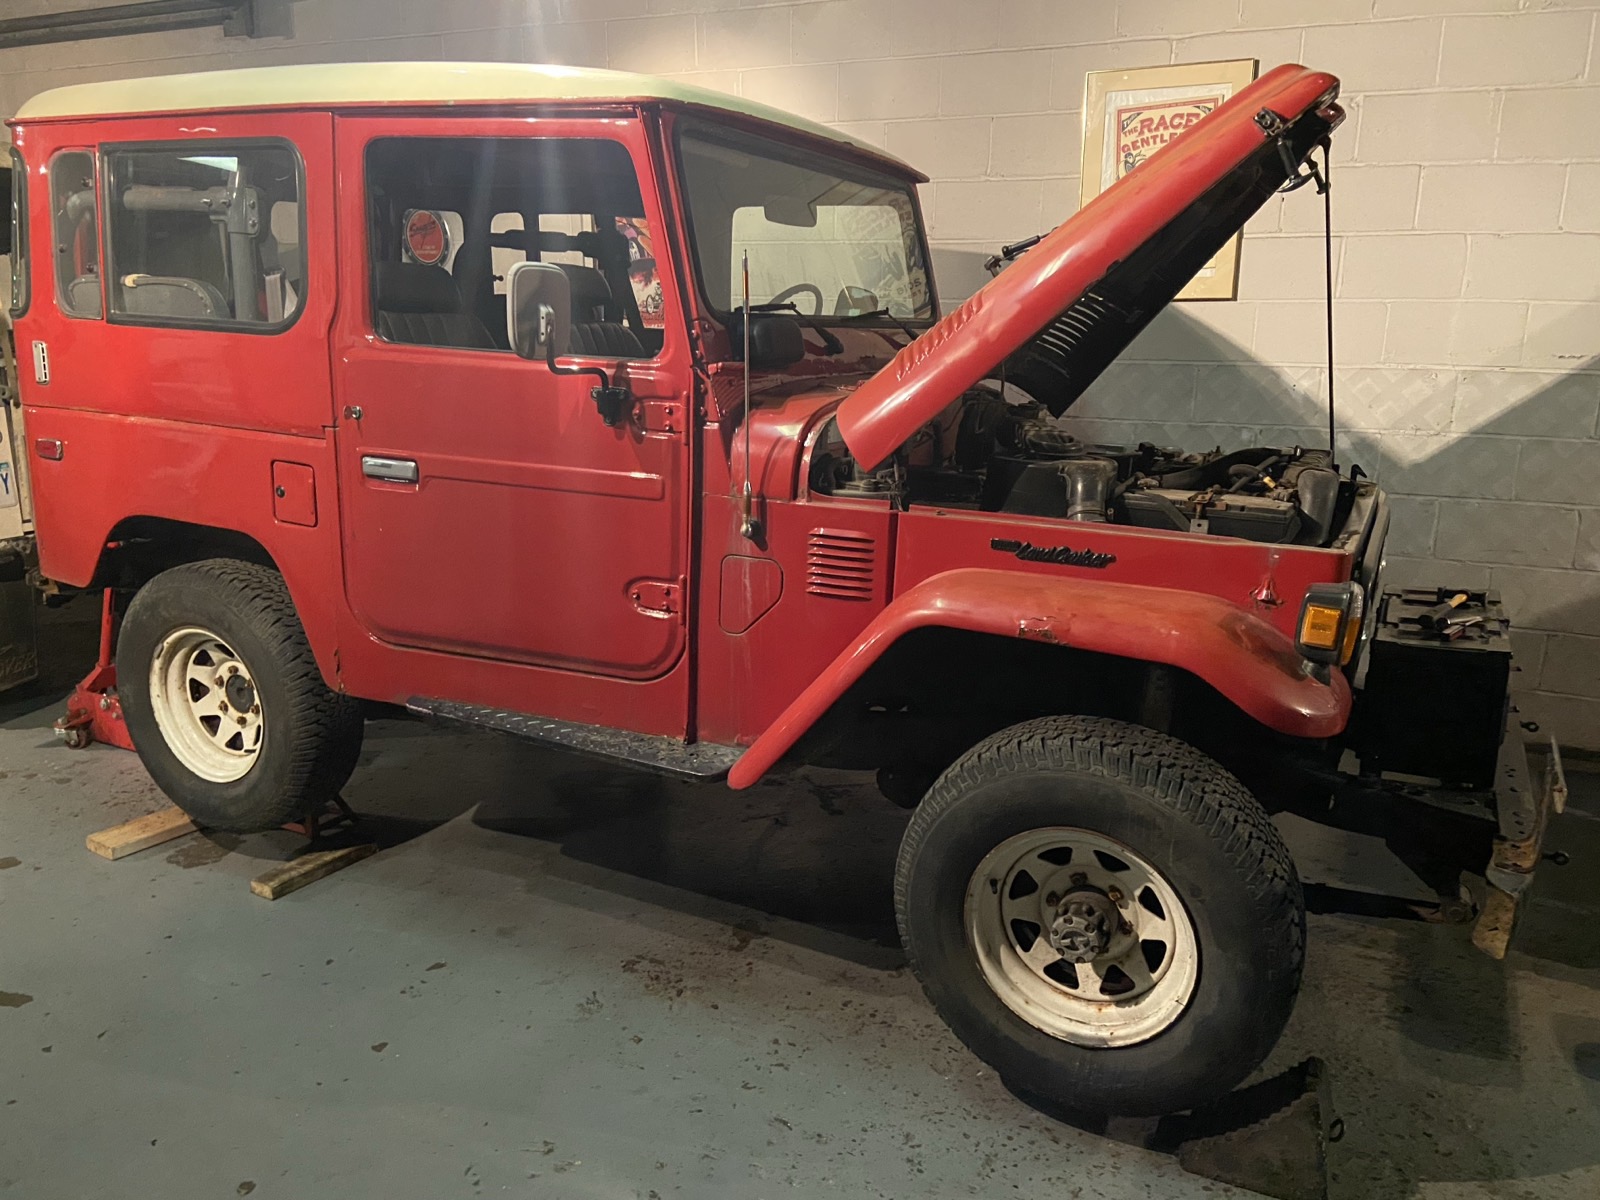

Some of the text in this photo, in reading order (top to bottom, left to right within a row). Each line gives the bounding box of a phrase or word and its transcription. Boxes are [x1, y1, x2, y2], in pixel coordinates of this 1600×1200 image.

[1122, 126, 1138, 137] THE
[1137, 112, 1201, 138] RACE
[1121, 132, 1184, 154] GENTLE
